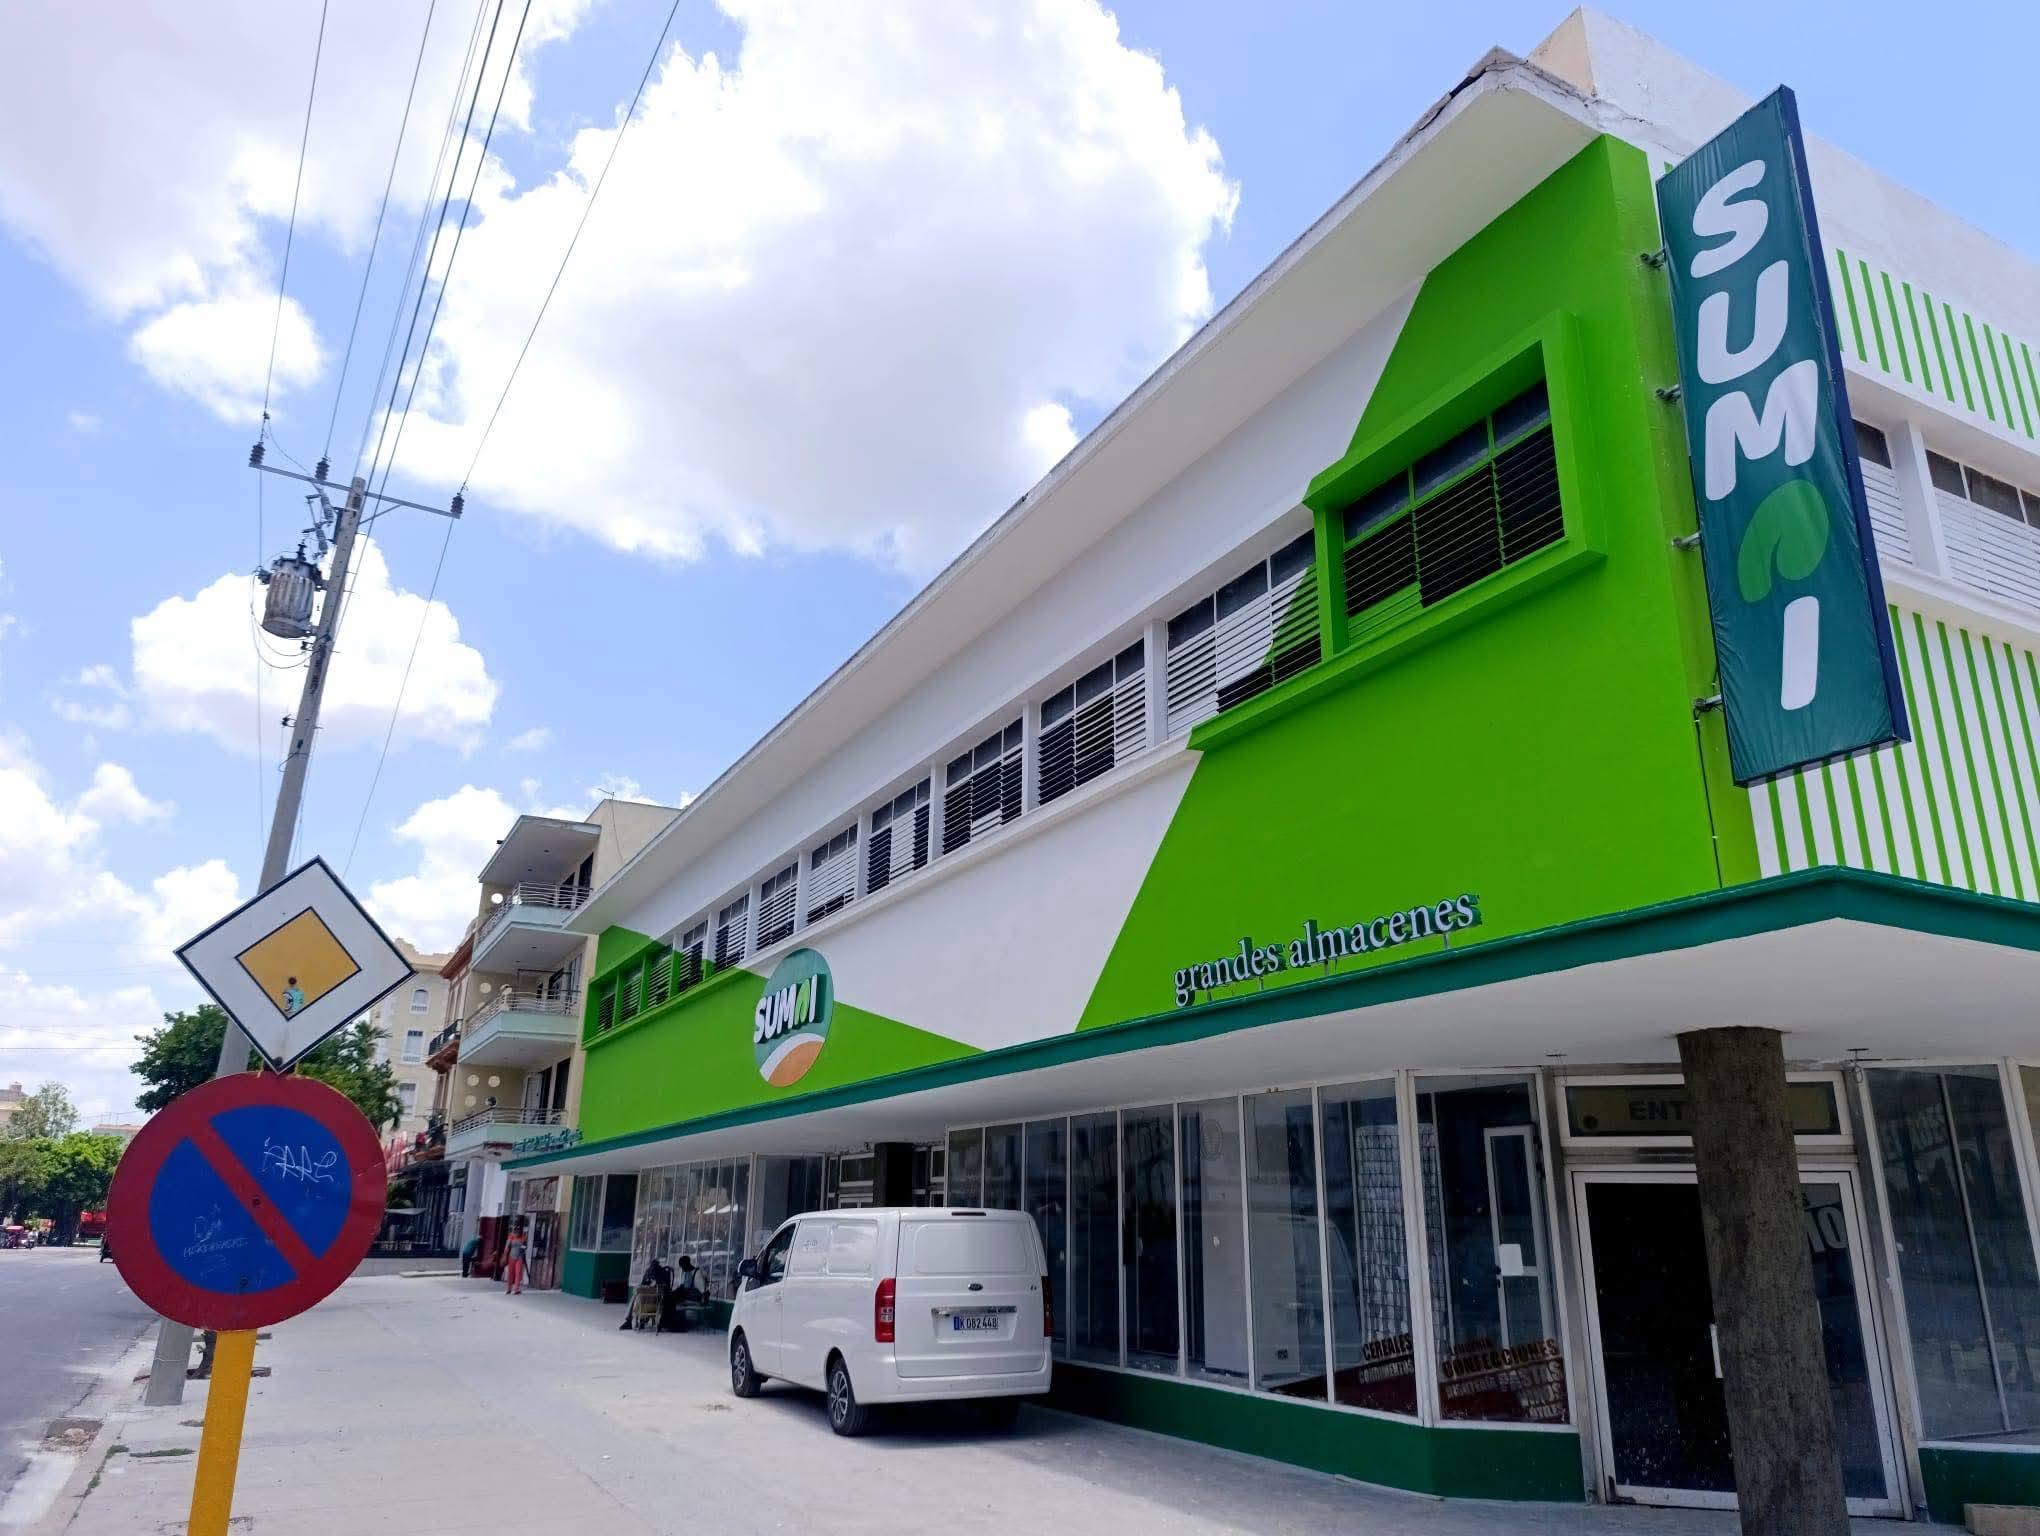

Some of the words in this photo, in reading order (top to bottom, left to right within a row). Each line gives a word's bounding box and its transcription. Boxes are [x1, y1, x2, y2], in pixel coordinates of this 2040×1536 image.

[1174, 937, 1284, 1007] grandes
[1289, 893, 1480, 968] almacenes
[1363, 1333, 1412, 1360] CEREALES
